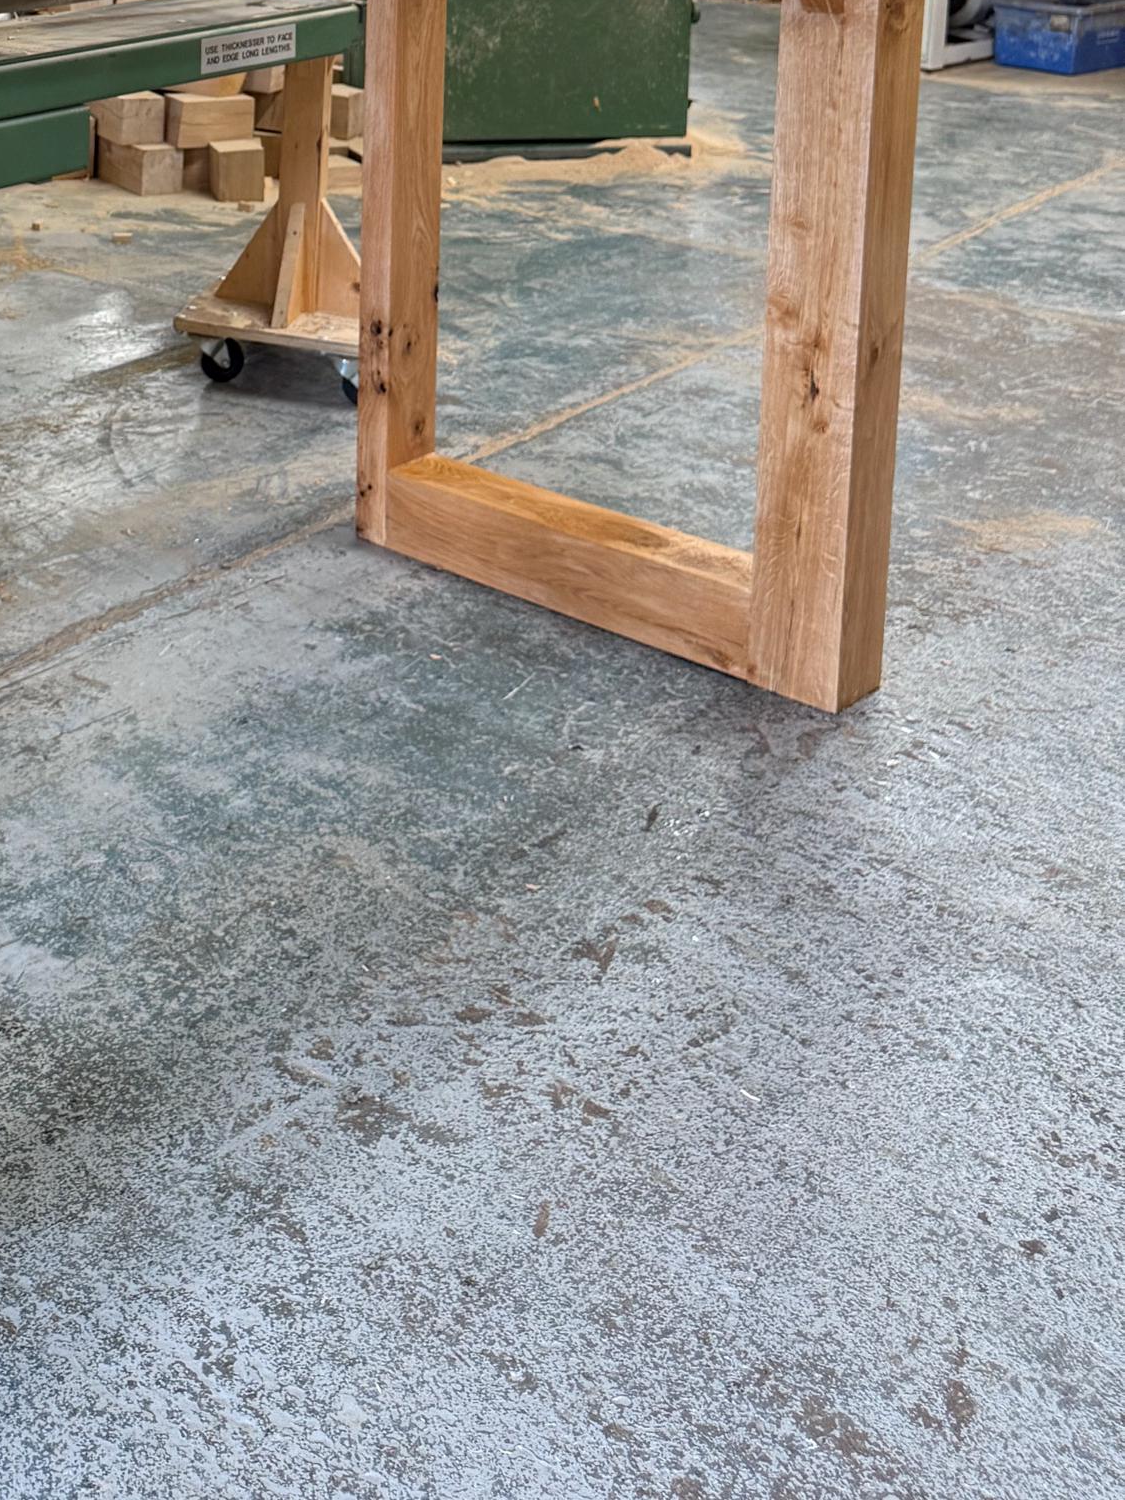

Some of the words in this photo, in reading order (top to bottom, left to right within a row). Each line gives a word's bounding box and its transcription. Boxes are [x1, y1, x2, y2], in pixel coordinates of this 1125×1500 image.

[204, 45, 219, 56] USE
[221, 36, 265, 52] THICKNESSER
[267, 35, 276, 45] TO
[277, 32, 293, 42] FACE
[206, 56, 220, 66] AND
[222, 52, 239, 63] EDGE
[241, 48, 259, 60] LONG
